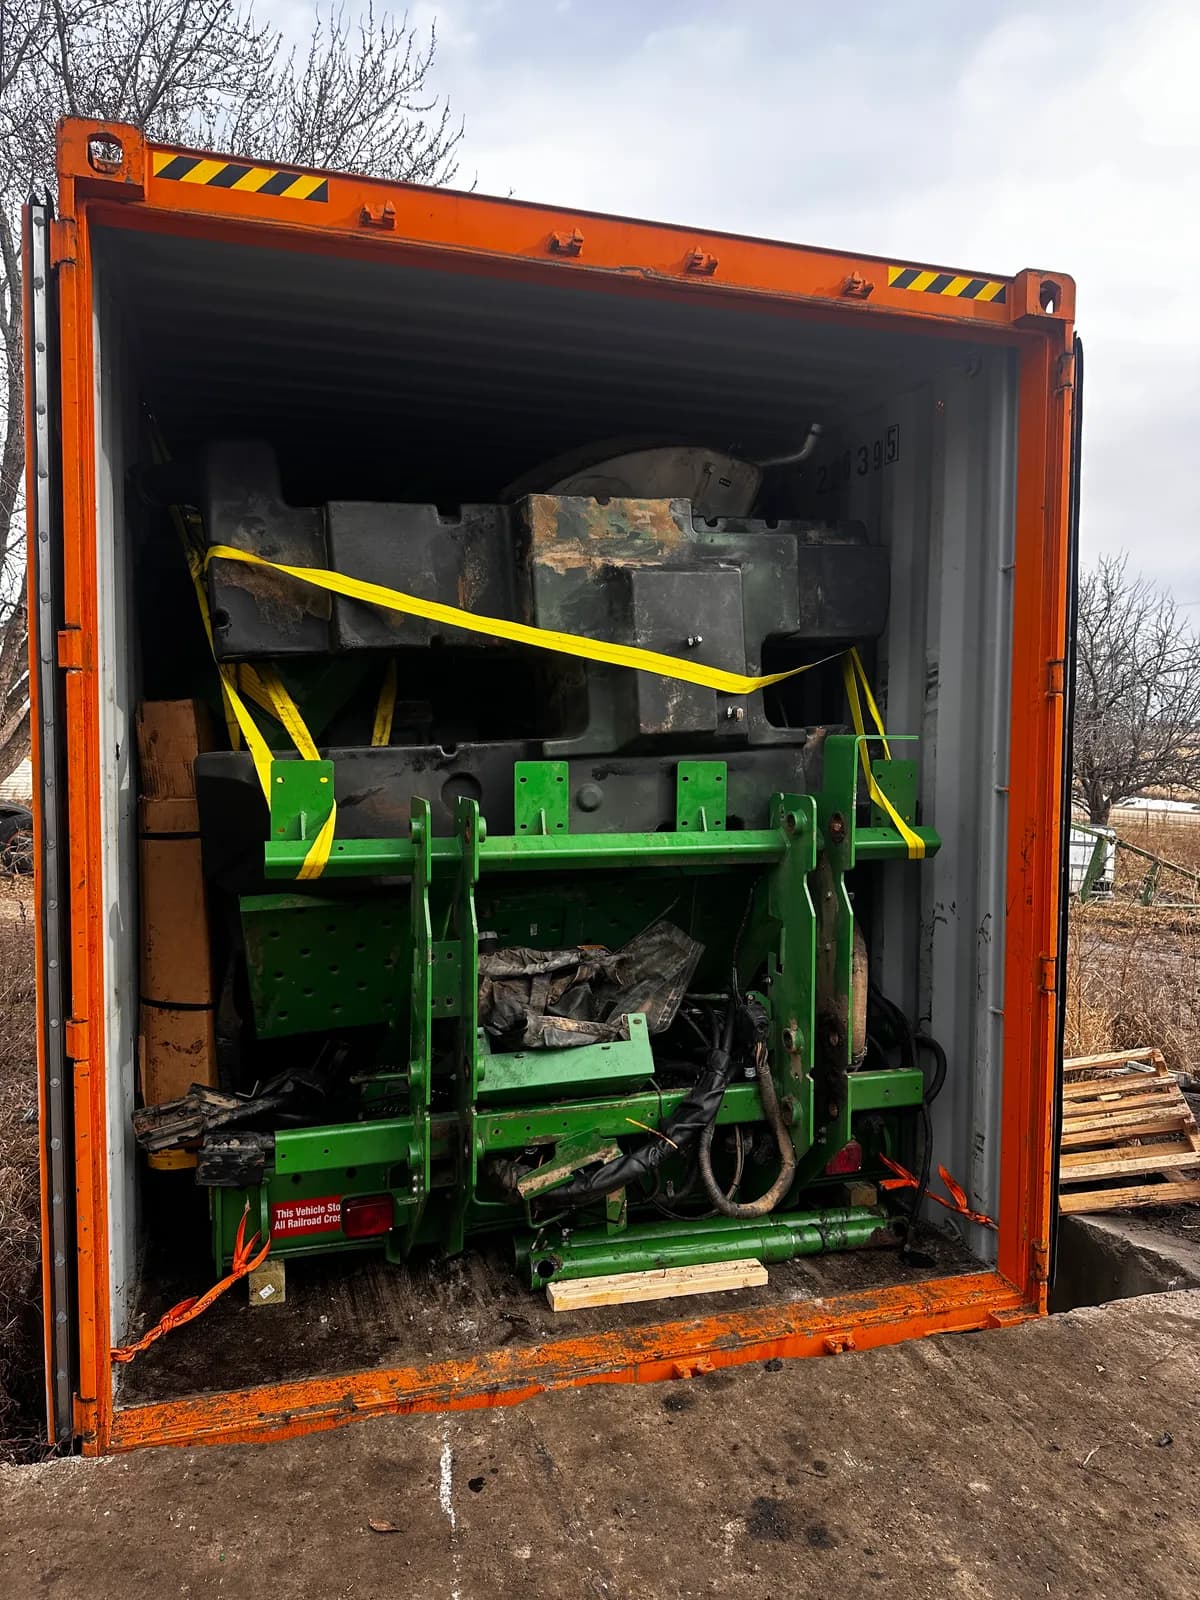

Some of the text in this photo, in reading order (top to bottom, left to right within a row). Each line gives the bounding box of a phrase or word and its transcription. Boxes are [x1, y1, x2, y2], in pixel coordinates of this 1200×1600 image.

[276, 1209, 294, 1219] This
[295, 1205, 326, 1216] Vehicle
[274, 1220, 286, 1230] All
[287, 1216, 322, 1228] Railroad
